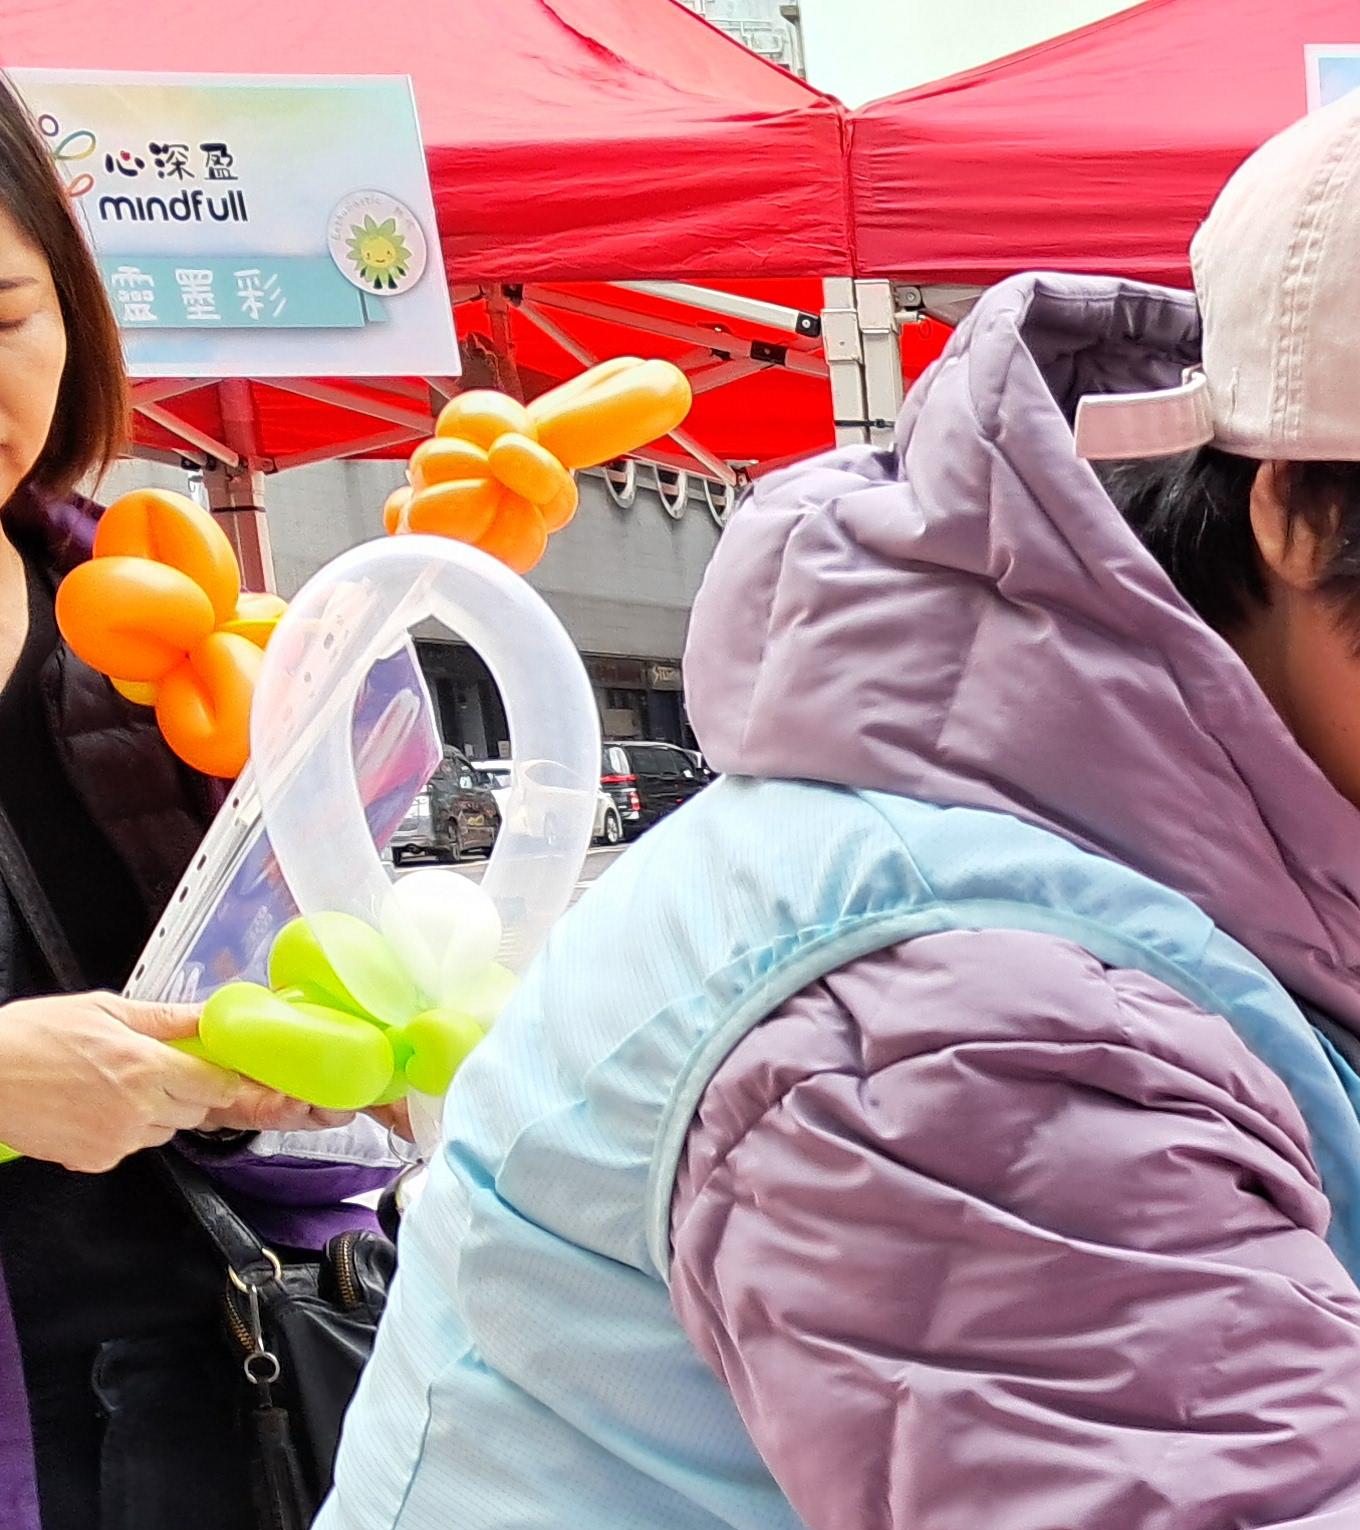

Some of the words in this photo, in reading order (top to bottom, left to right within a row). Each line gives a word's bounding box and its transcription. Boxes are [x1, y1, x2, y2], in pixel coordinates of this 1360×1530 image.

[105, 142, 239, 181] 心深盈
[98, 189, 249, 222] mindfull
